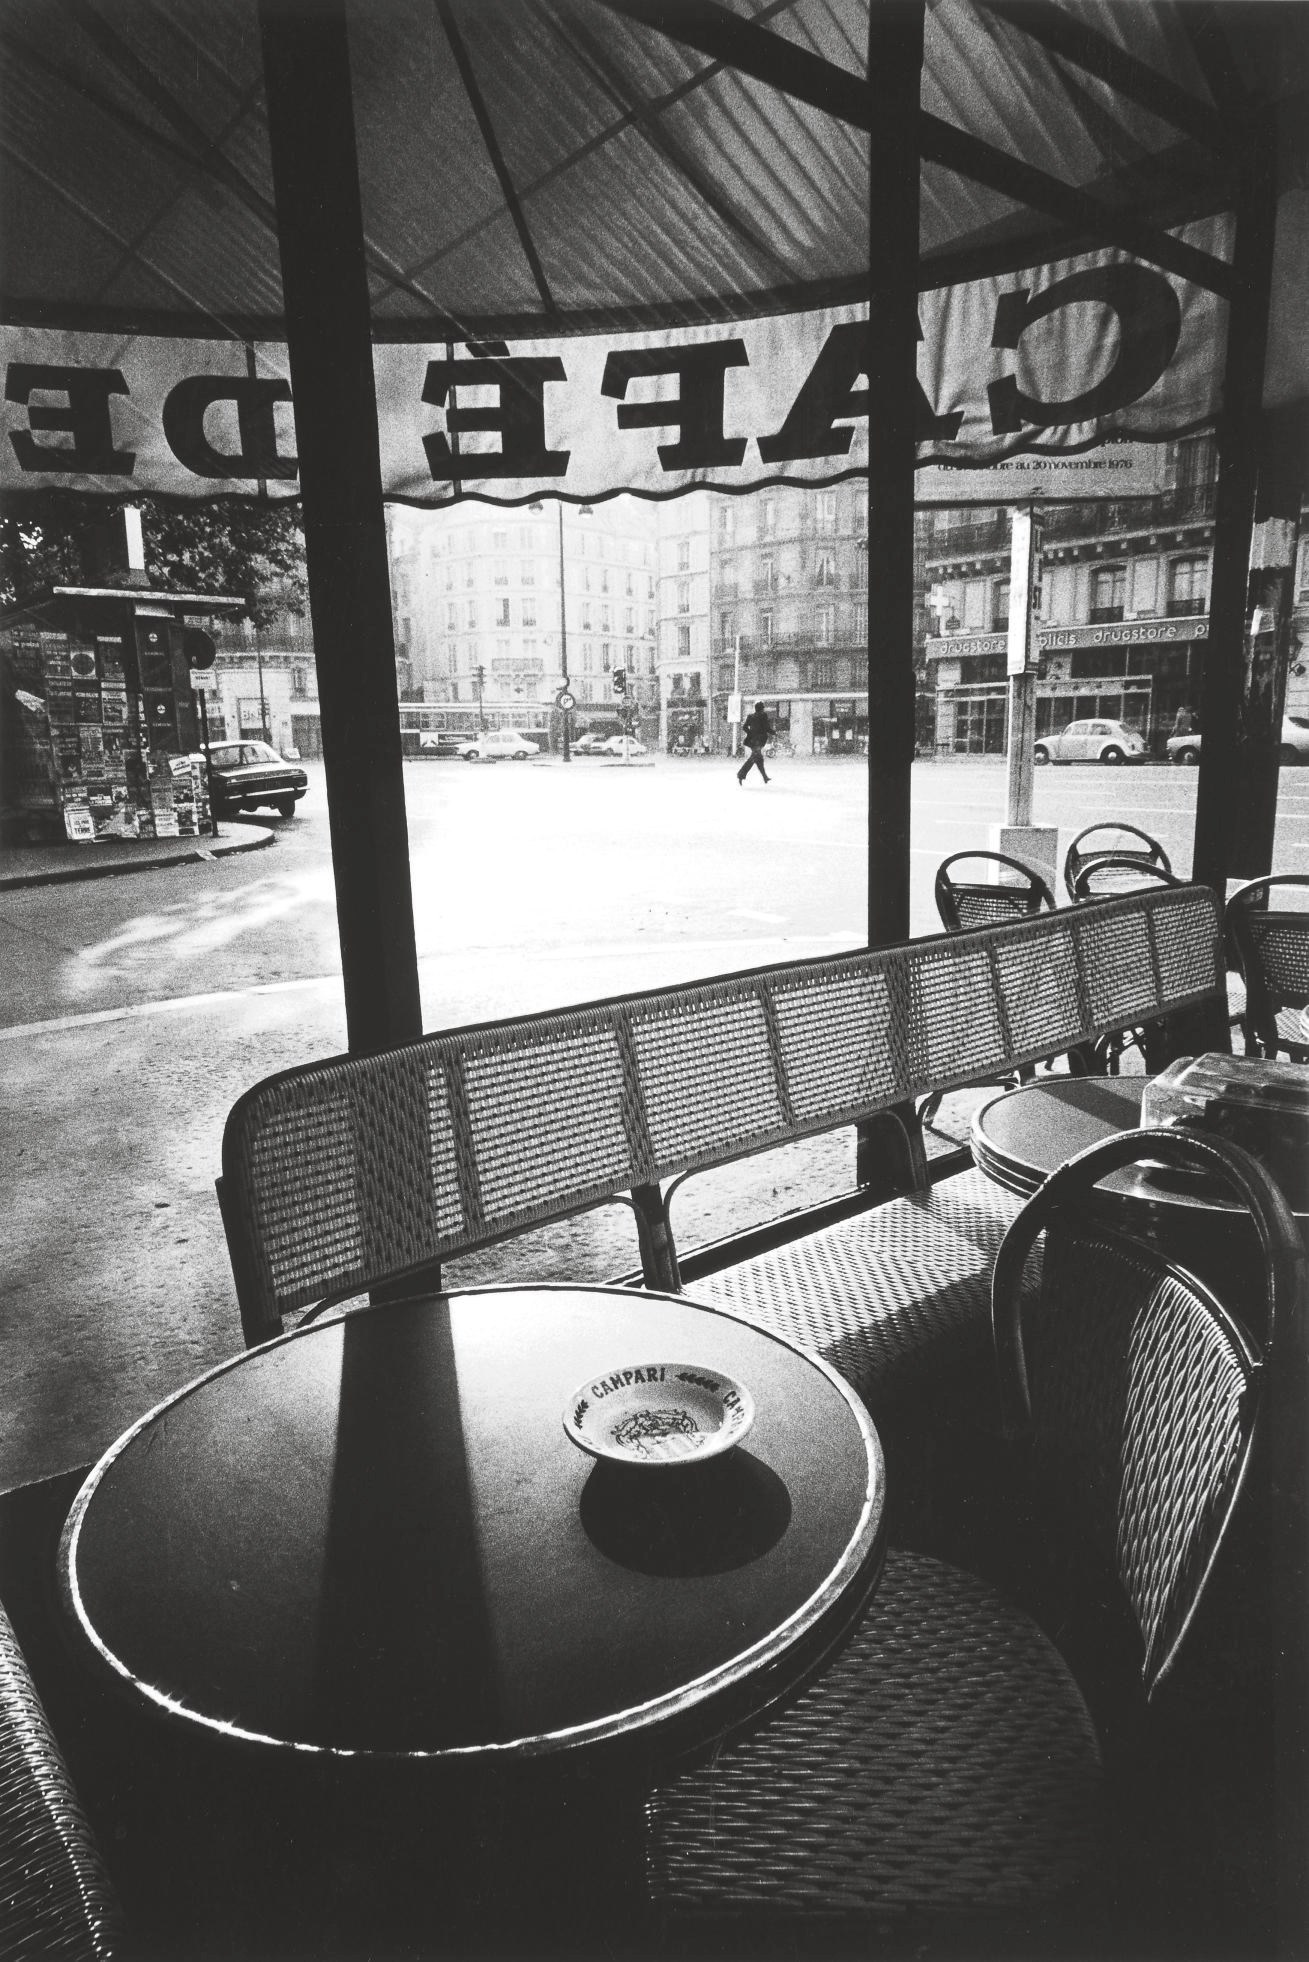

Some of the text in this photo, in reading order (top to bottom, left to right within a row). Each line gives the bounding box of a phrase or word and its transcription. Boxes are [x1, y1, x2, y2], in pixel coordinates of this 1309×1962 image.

[1015, 461, 1031, 470] au
[1032, 460, 1047, 471] 20
[1049, 459, 1106, 470] novembre
[1107, 459, 1133, 469] 1976
[940, 640, 1006, 654] drugstore
[1093, 626, 1177, 642] drugstore
[591, 1367, 666, 1399] CAMPARI
